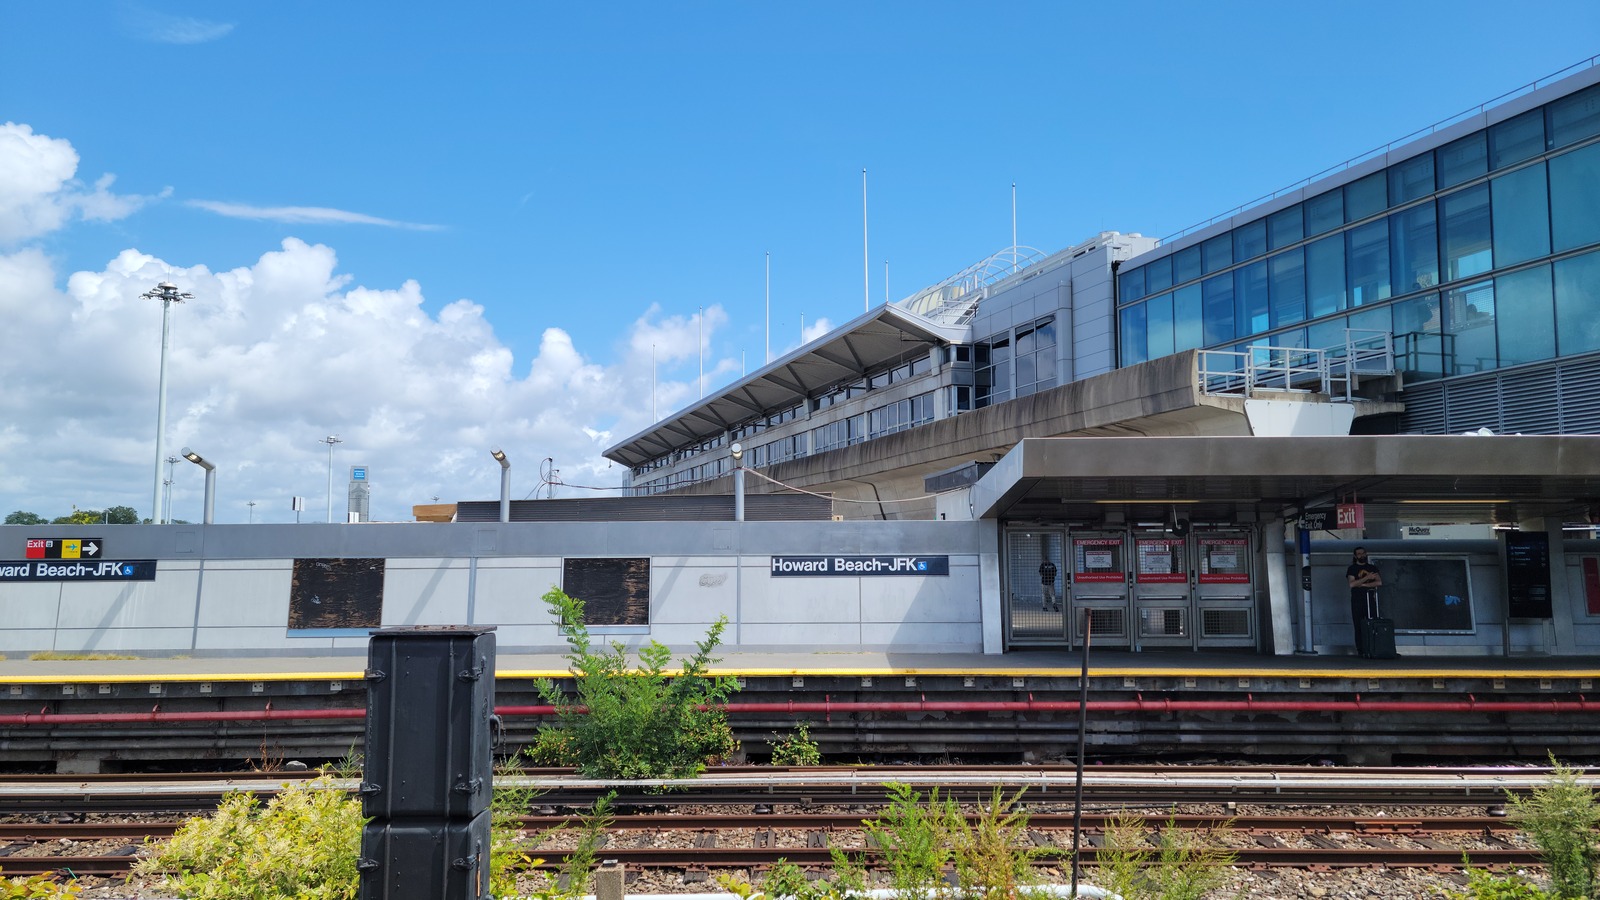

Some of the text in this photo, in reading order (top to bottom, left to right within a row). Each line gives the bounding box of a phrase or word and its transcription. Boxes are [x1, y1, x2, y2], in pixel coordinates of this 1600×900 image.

[1305, 512, 1327, 521] Emergency
[1337, 508, 1356, 524] Exit
[1305, 520, 1324, 530] Exit Only
[26, 540, 44, 548] Exit
[36, 562, 123, 577] Beach-JFK
[772, 557, 918, 572] Howard Beach-JFK
